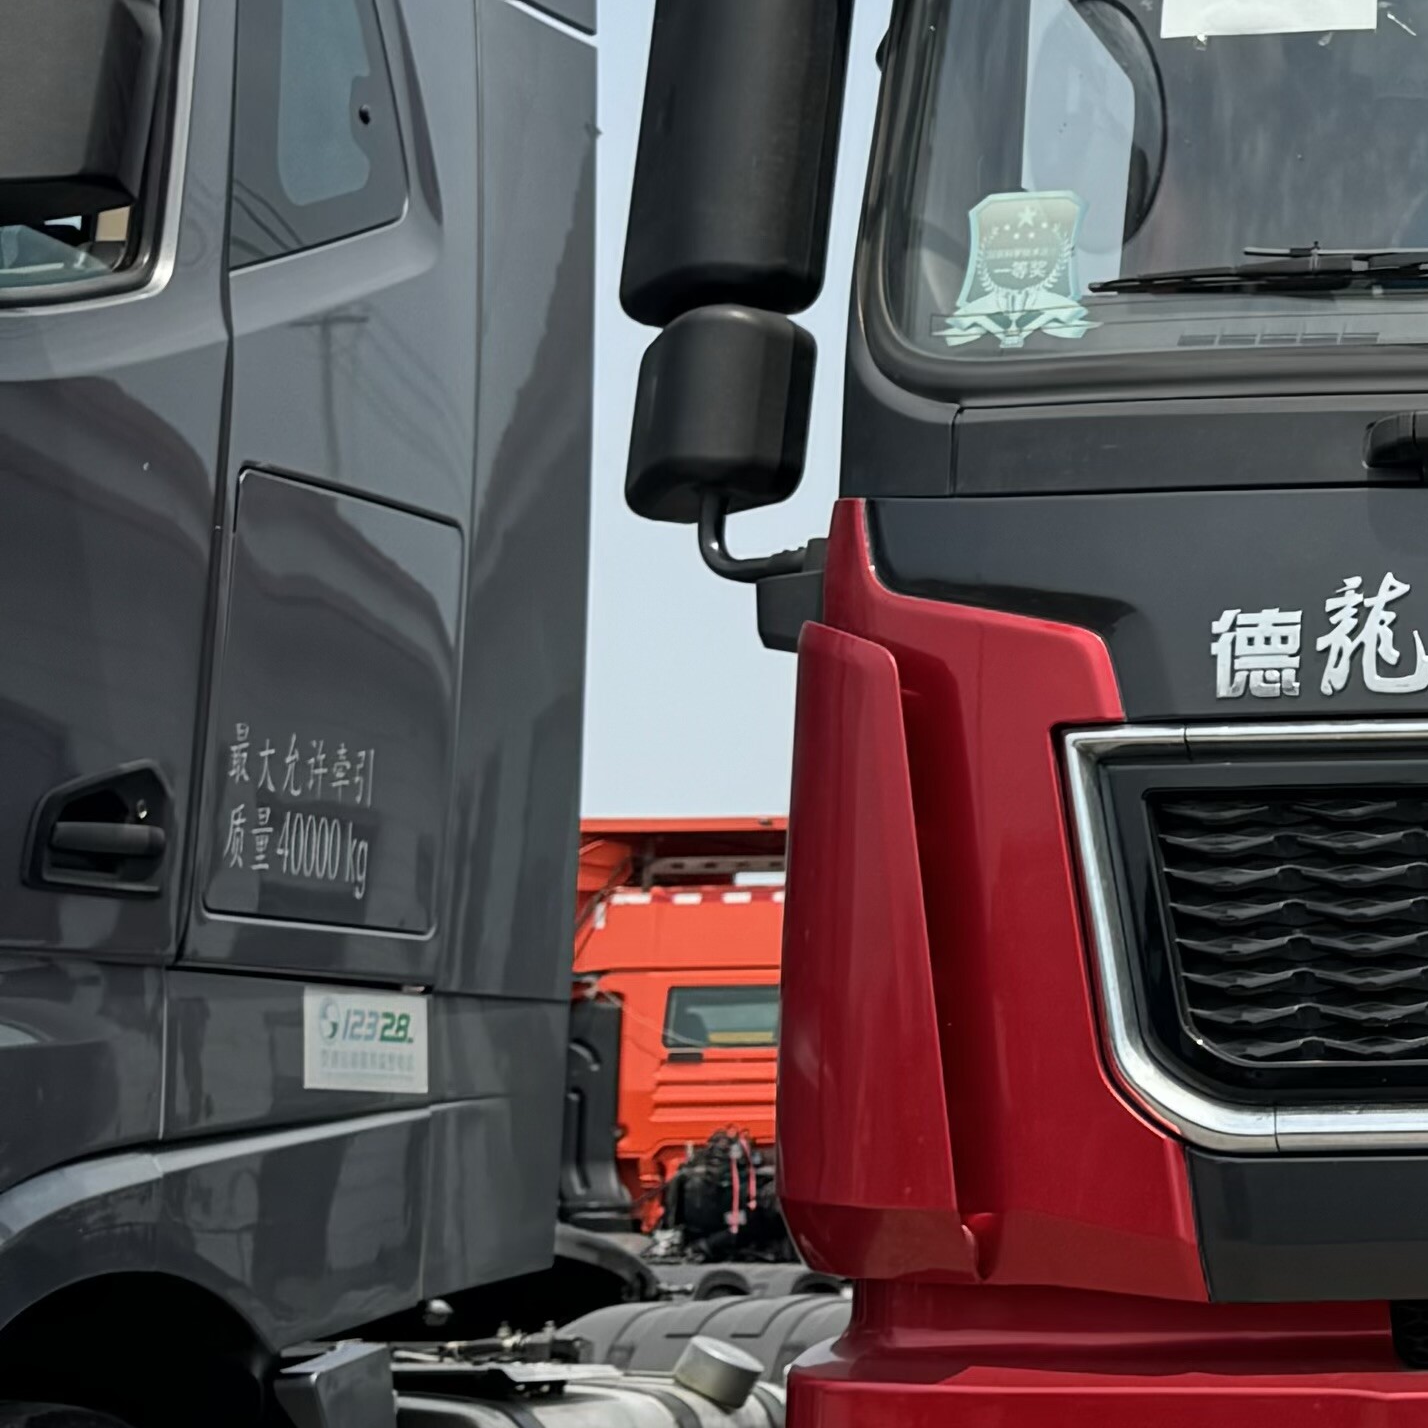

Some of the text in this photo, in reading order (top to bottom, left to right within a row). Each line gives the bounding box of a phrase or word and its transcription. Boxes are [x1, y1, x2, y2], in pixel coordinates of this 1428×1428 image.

[227, 722, 375, 808] 最大允许牵引
